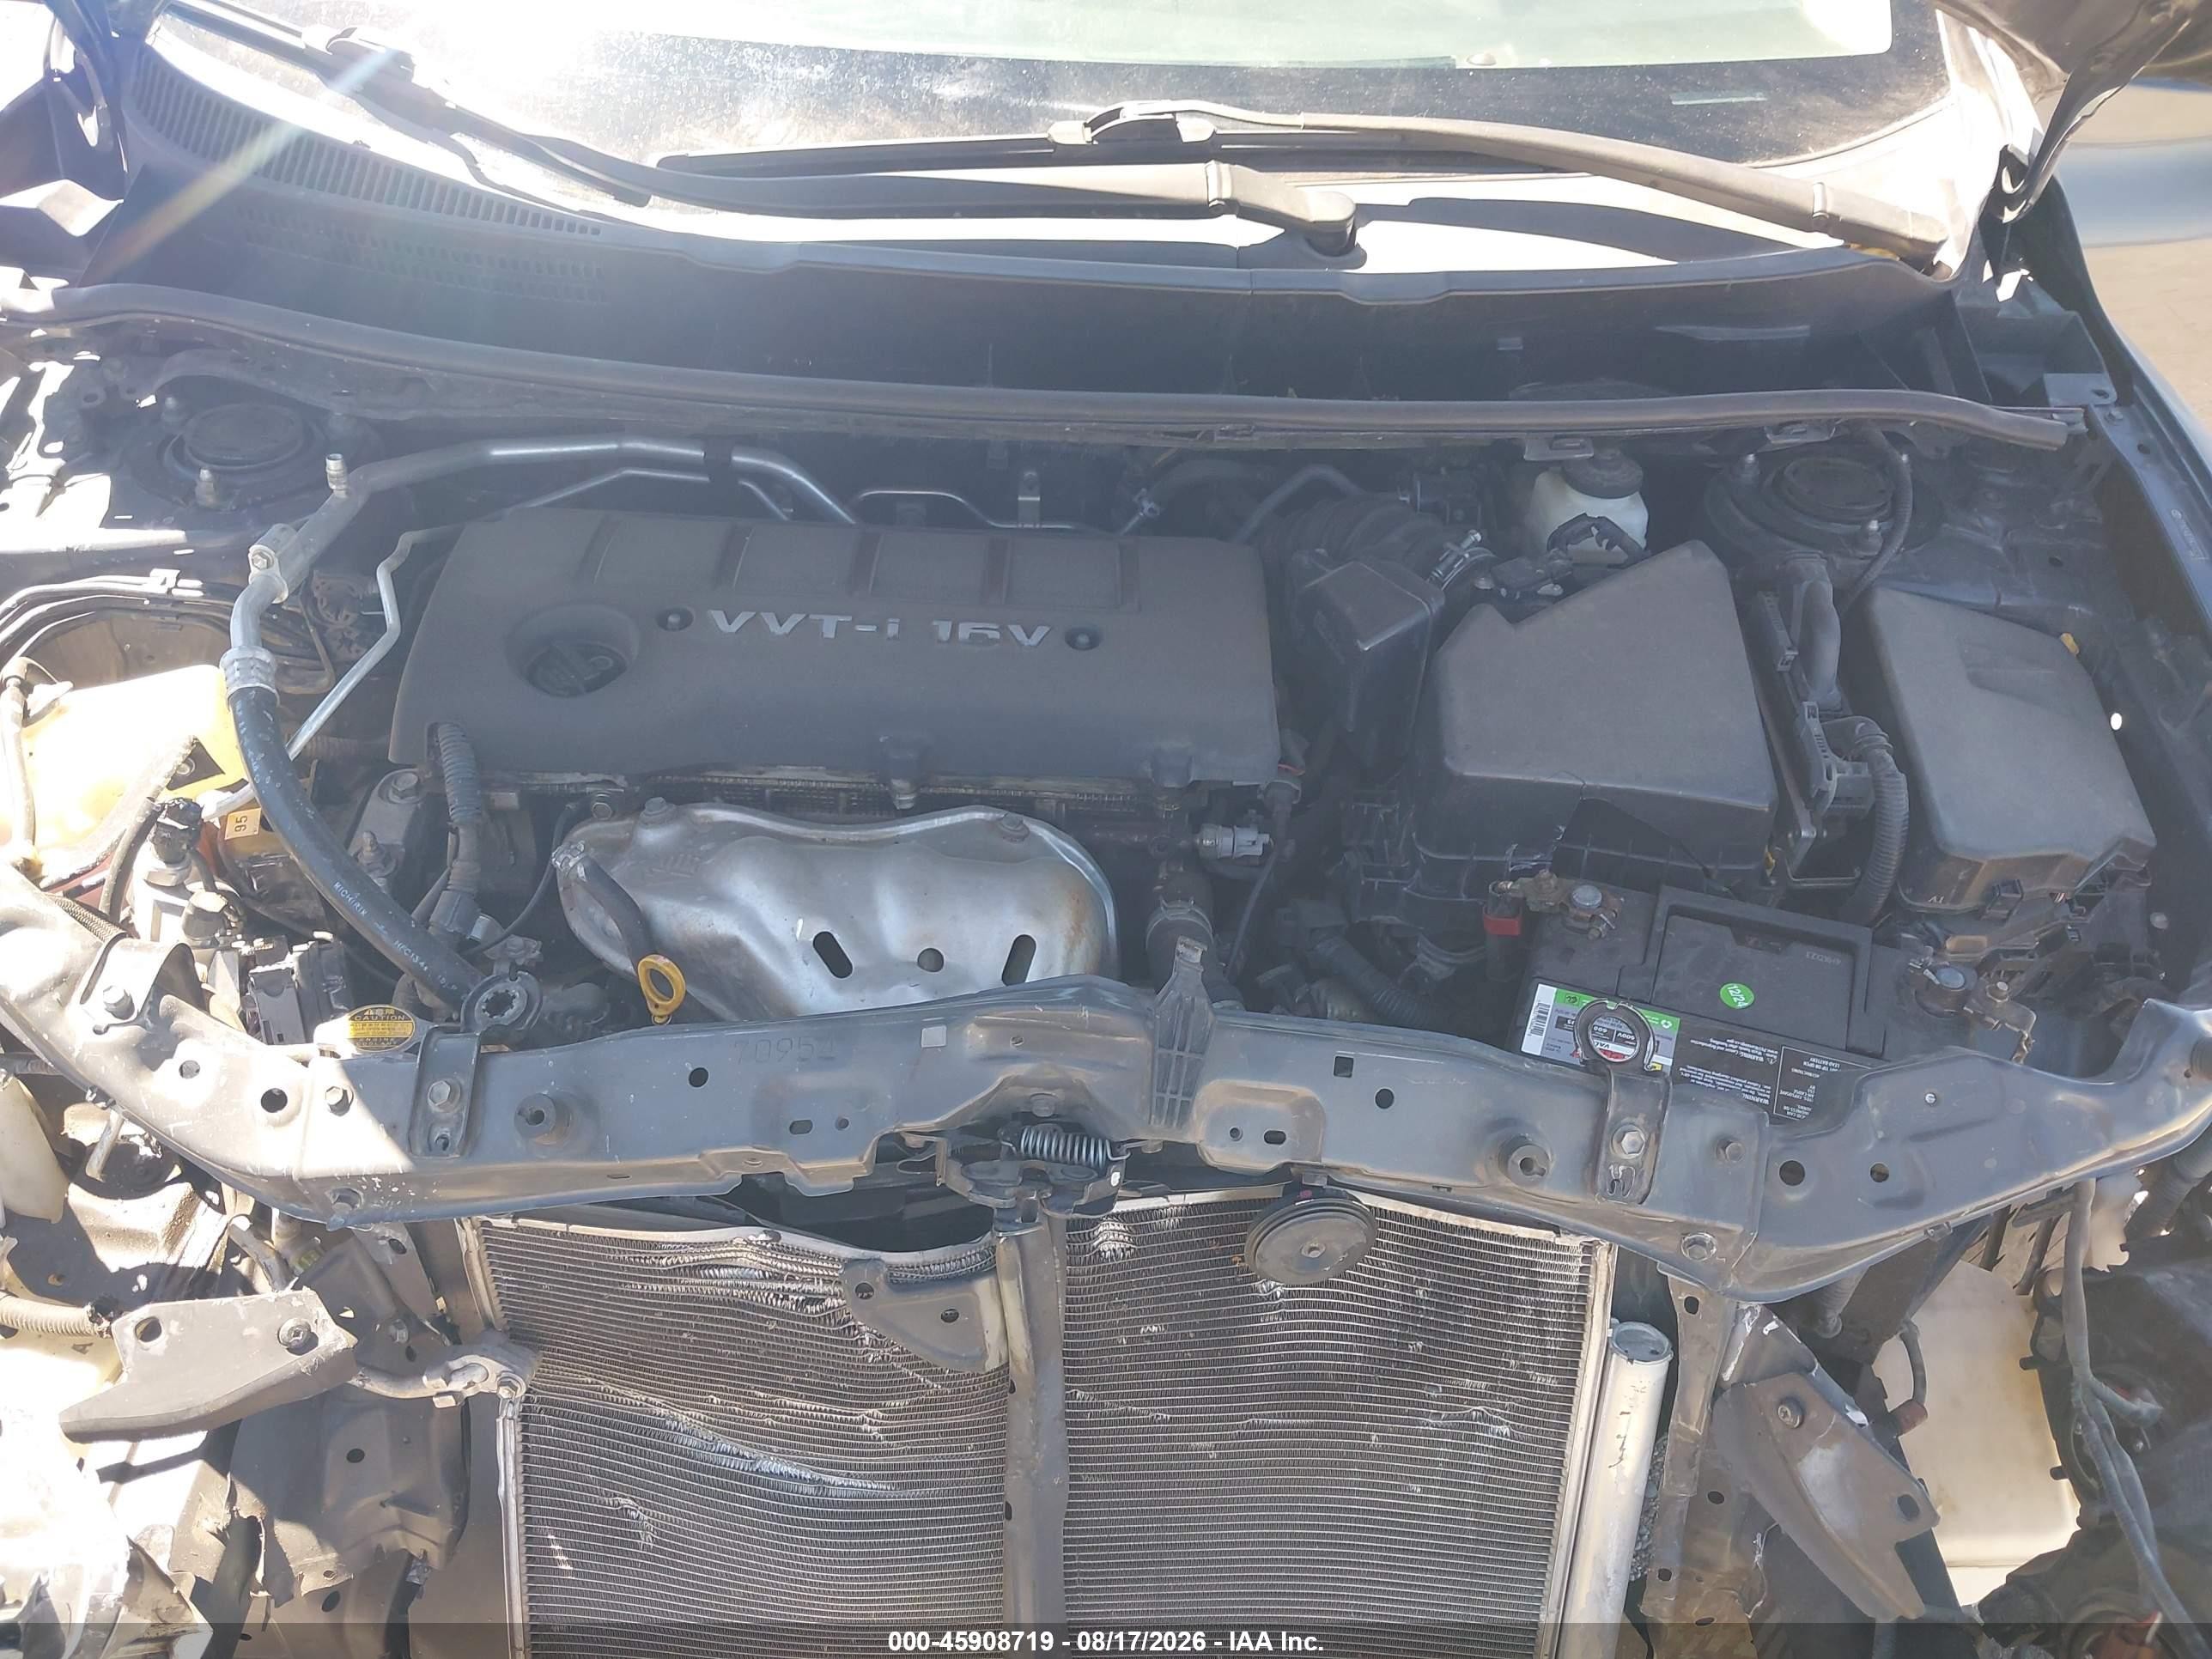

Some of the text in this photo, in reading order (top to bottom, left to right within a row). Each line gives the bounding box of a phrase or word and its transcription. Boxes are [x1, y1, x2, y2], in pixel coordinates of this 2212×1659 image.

[708, 610, 1052, 649] VVT-i 16V
[234, 816, 247, 832] 95
[1727, 985, 1748, 1008] 12/24
[1809, 1057, 1829, 1066] BATTERY
